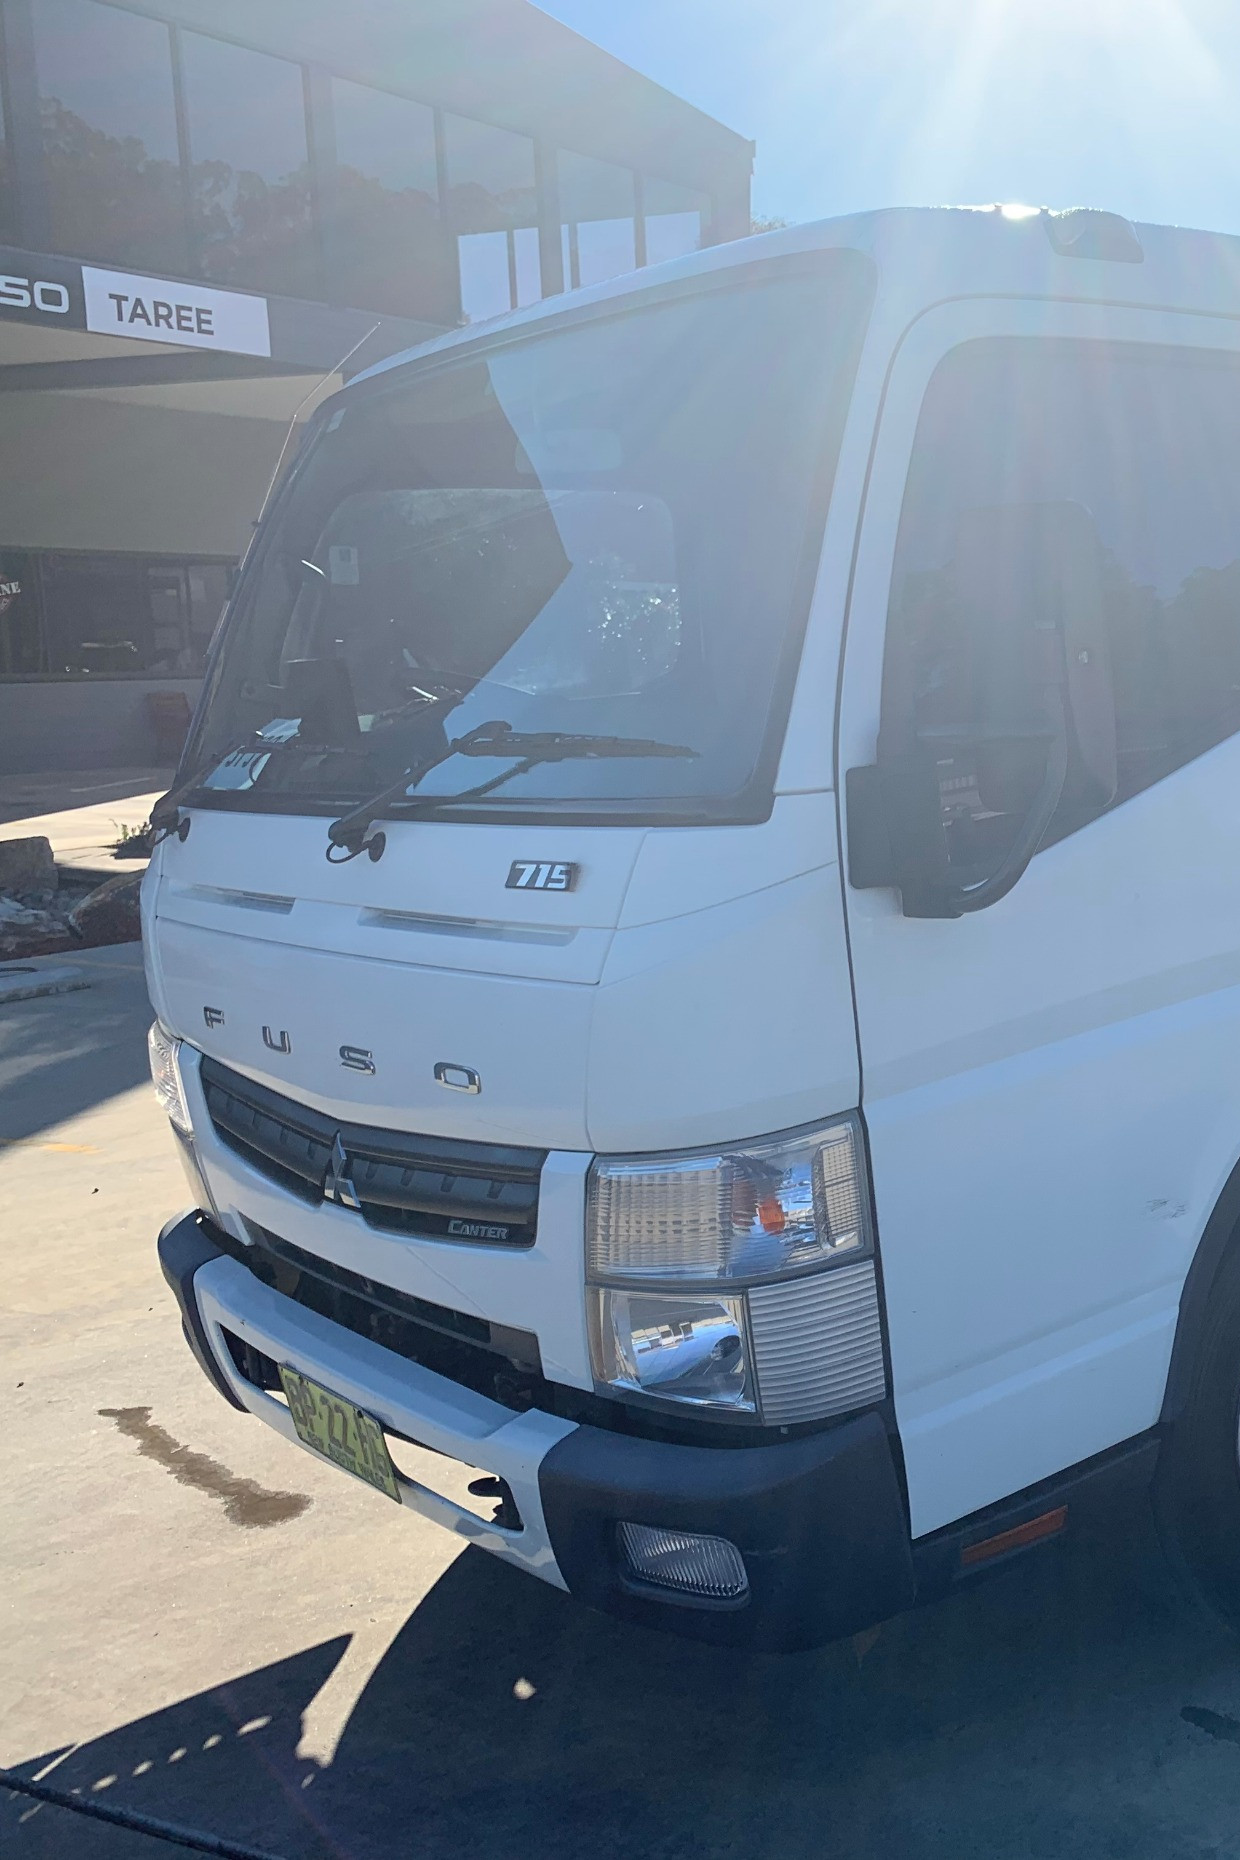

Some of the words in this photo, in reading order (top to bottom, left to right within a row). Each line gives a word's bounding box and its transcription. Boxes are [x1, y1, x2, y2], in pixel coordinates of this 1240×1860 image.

[108, 293, 215, 336] TAREE
[514, 863, 568, 889] 715
[203, 1005, 482, 1095] FUSO
